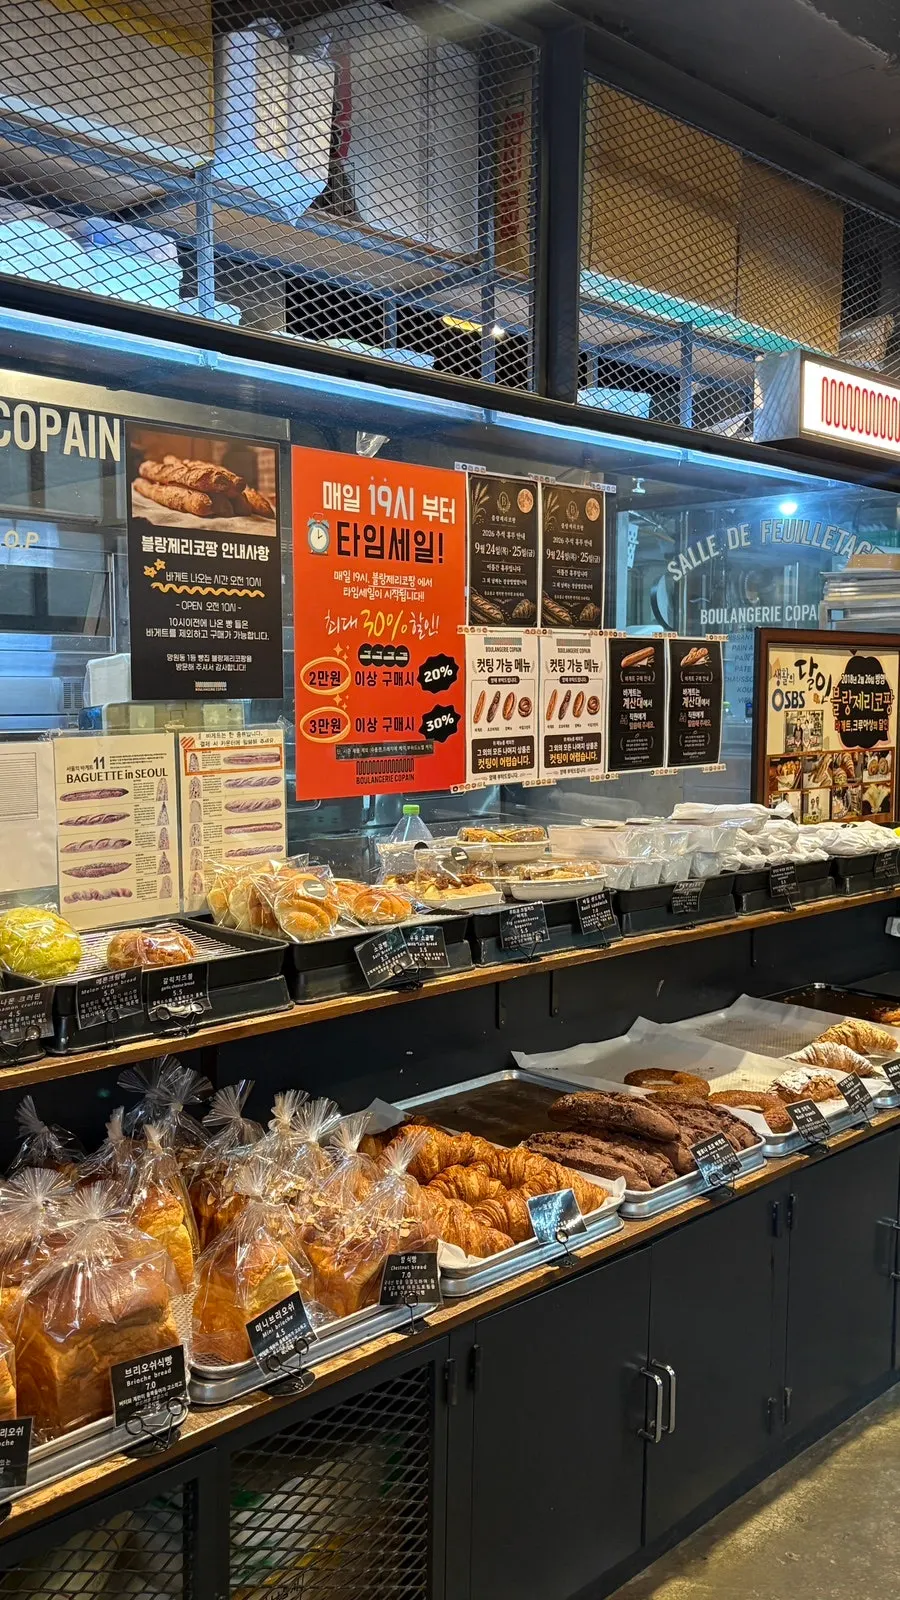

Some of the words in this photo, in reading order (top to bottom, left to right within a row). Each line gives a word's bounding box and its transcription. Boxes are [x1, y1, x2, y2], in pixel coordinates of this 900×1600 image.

[322, 481, 361, 514] 매일
[368, 484, 415, 521] 19시
[422, 494, 456, 525] 부터
[141, 535, 218, 558] 블랑제리코팡
[222, 542, 270, 562] 안내사항
[337, 520, 443, 564] 타임세일!
[667, 534, 720, 582] SALLE
[727, 523, 752, 550] DE
[165, 570, 189, 584] 바게트
[190, 573, 212, 585] 나오는
[213, 574, 228, 586] 시간
[230, 575, 244, 587] 오전
[246, 576, 262, 588] 10시
[334, 569, 351, 584] 매일
[372, 571, 415, 588] 블랑제리코팡
[417, 577, 433, 588] 에서
[343, 586, 383, 601] 타임세일이
[181, 600, 203, 611] OPEN
[206, 601, 219, 612] 오전
[221, 602, 237, 613] 10시
[209, 619, 224, 629] 나온
[225, 619, 233, 629] 빵
[700, 605, 782, 626] BOULANGERIE
[324, 609, 358, 635] 최대
[360, 609, 408, 641] 30%
[146, 628, 177, 639] 바게트를
[178, 629, 208, 640] 제외하고
[210, 630, 232, 640] 구매가
[233, 631, 270, 641] 가능합니다.
[423, 664, 453, 684] 20%
[476, 658, 494, 673] 컷팅
[496, 658, 513, 673] 가능
[514, 658, 531, 673] 메뉴
[549, 658, 566, 673] 컷팅
[567, 658, 583, 673] 가능
[584, 658, 599, 673] 메뉴
[309, 670, 342, 687] 2만원
[355, 670, 378, 687] 이상
[382, 670, 415, 687] 구매시
[784, 690, 806, 709] SBS
[830, 686, 895, 717] 블랑제리코팡
[309, 717, 342, 735] 3만원
[355, 716, 378, 733] 이상
[382, 716, 415, 732] 구매시
[425, 712, 455, 733] 30%
[93, 756, 105, 770] 11
[477, 757, 498, 770] 컷팅이
[499, 755, 531, 768] 어렵습니다.
[549, 753, 569, 765] 컷팅이
[569, 751, 598, 763] 어렵습니다.
[66, 770, 124, 784] BAGUETTE
[125, 770, 134, 780] in
[135, 767, 169, 779] SEOUL
[356, 775, 394, 785] BOULANGERIE
[103, 988, 115, 997] 5.0
[255, 1301, 295, 1333] 미니브리오쉬
[262, 1328, 274, 1338] Mini
[275, 1328, 286, 1338] 4.5
[124, 1355, 173, 1378] 브리오쉬식빵
[126, 1375, 152, 1387] Brioche
[153, 1367, 172, 1379] bread
[145, 1380, 156, 1391] 7.0
